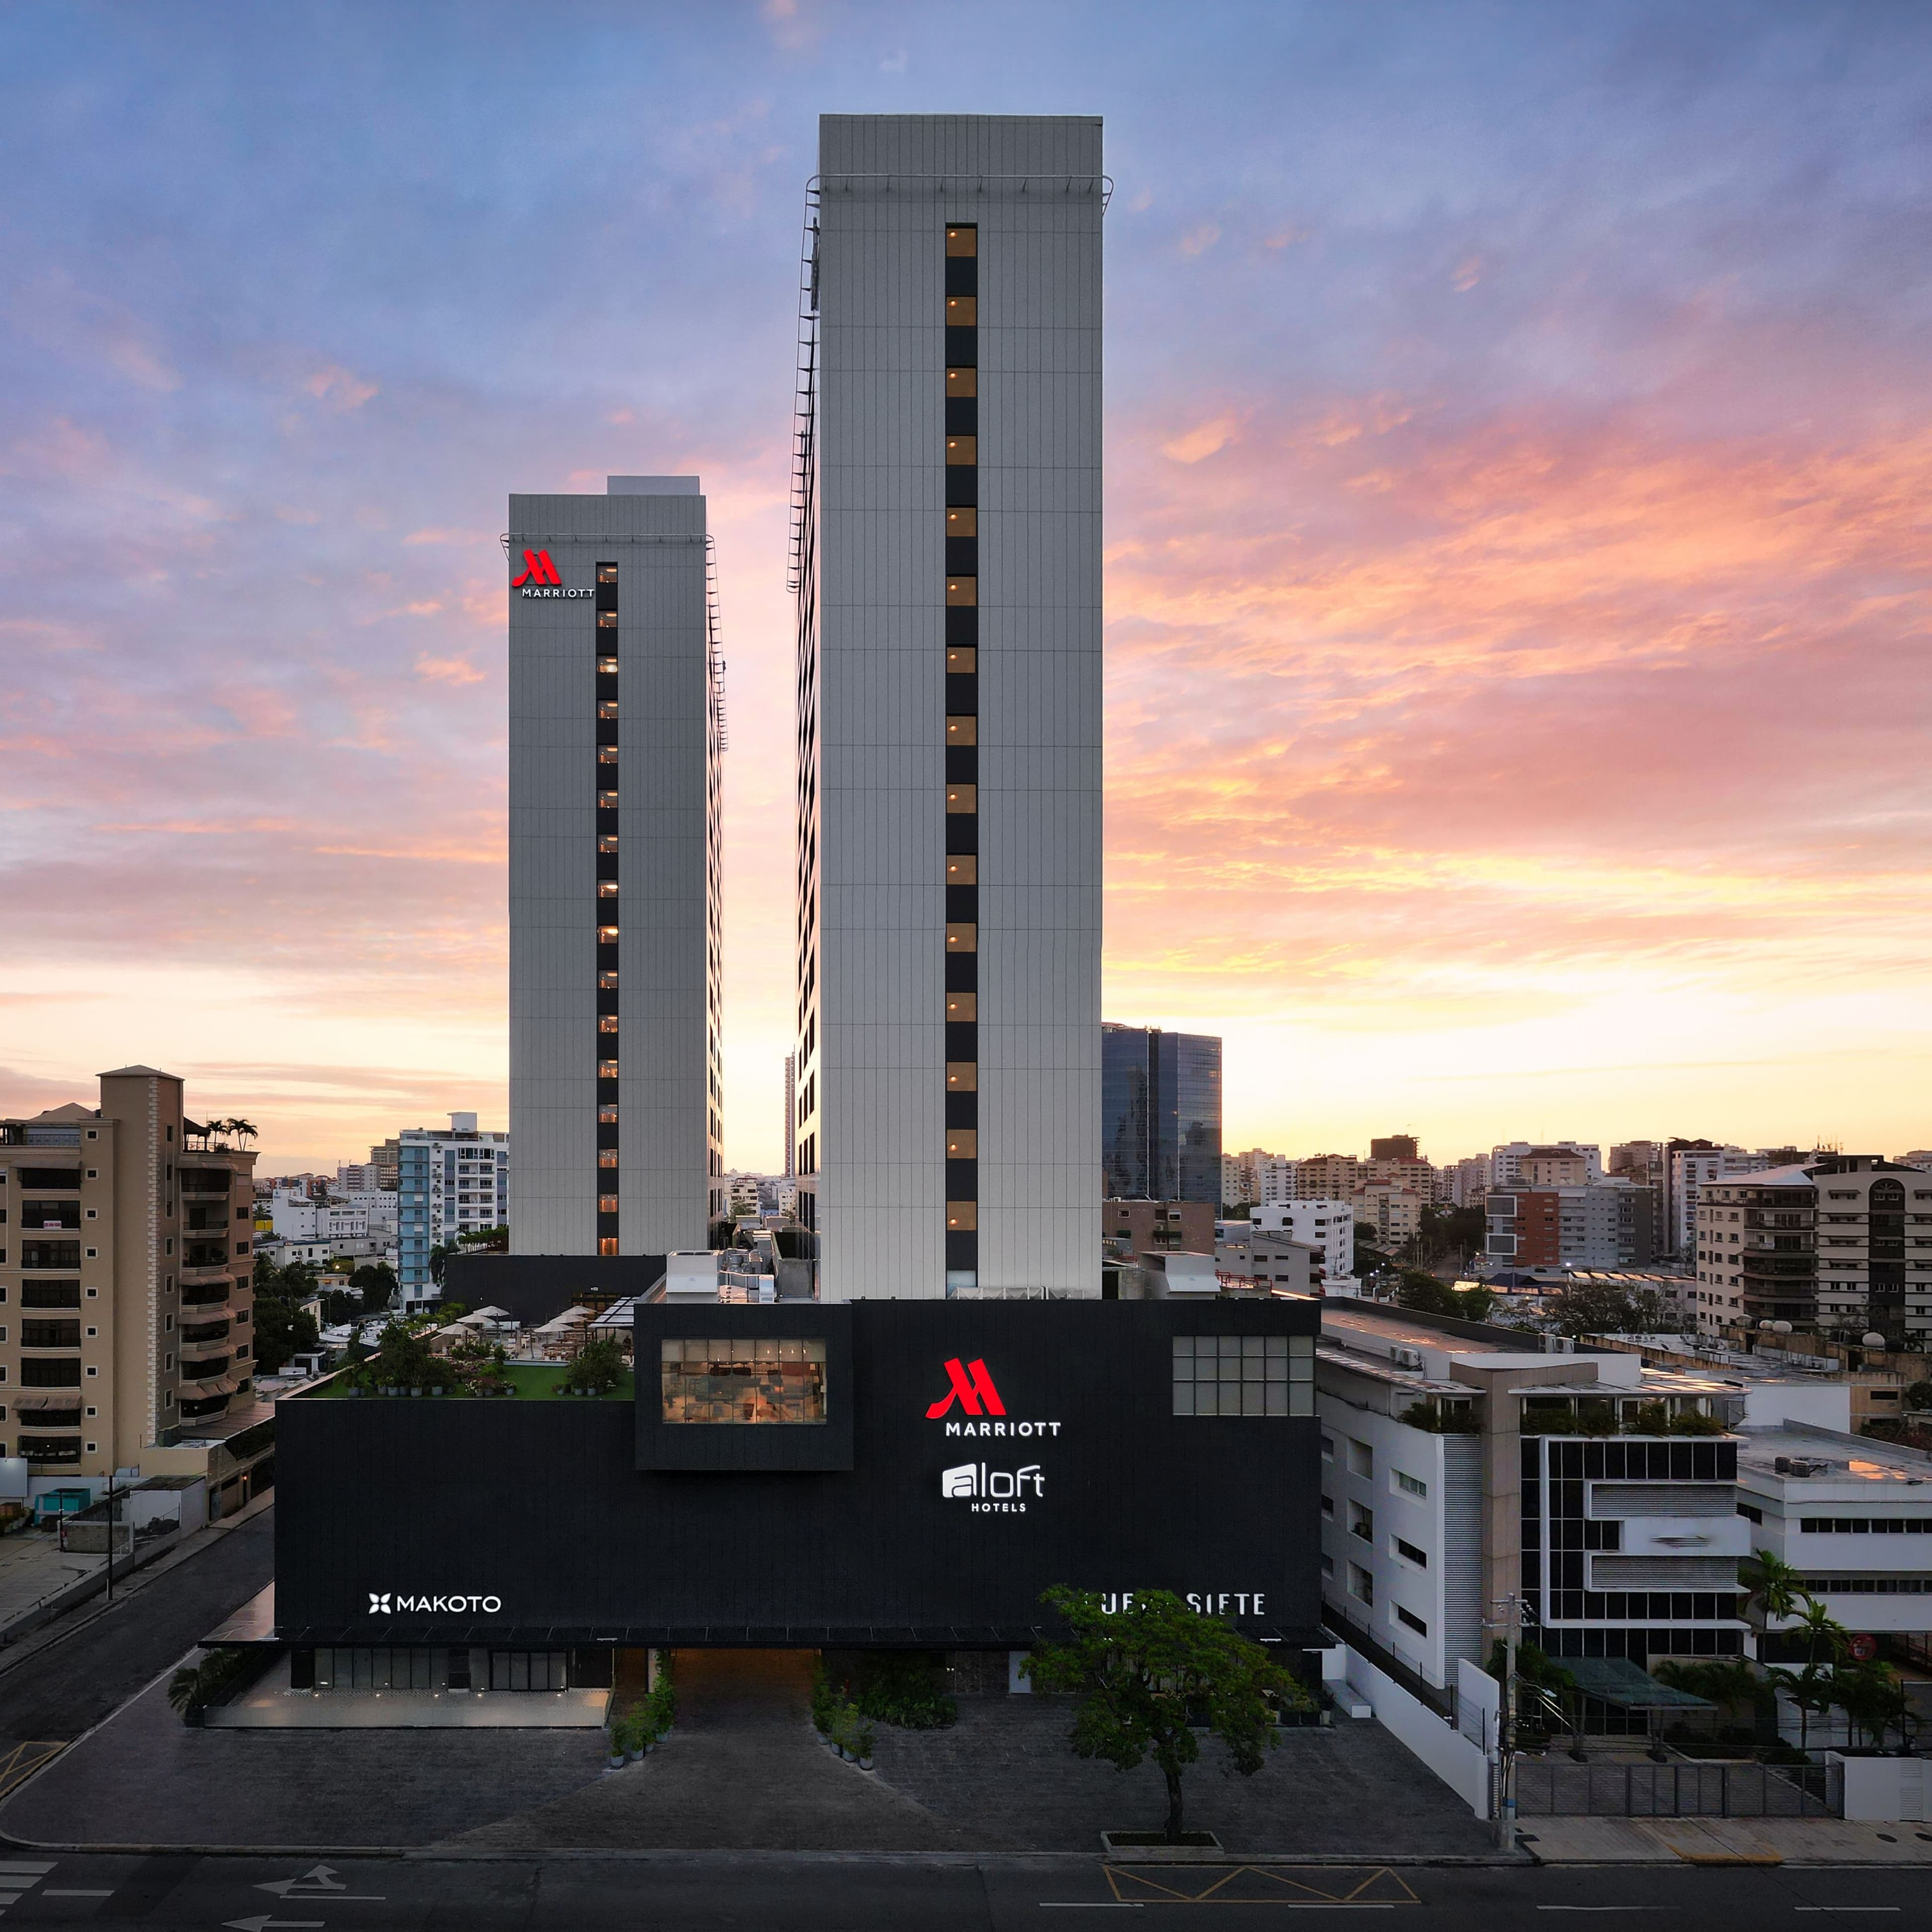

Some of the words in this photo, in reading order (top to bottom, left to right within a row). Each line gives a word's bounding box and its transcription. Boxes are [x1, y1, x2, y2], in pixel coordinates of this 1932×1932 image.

[522, 588, 595, 598] MARRIOTT
[946, 1422, 1061, 1436] MARRIOTT
[942, 1462, 1045, 1498] aloft
[972, 1503, 1026, 1512] HOTELS
[396, 1595, 501, 1613] MAKOTO
[1186, 1593, 1265, 1615] SIETE
